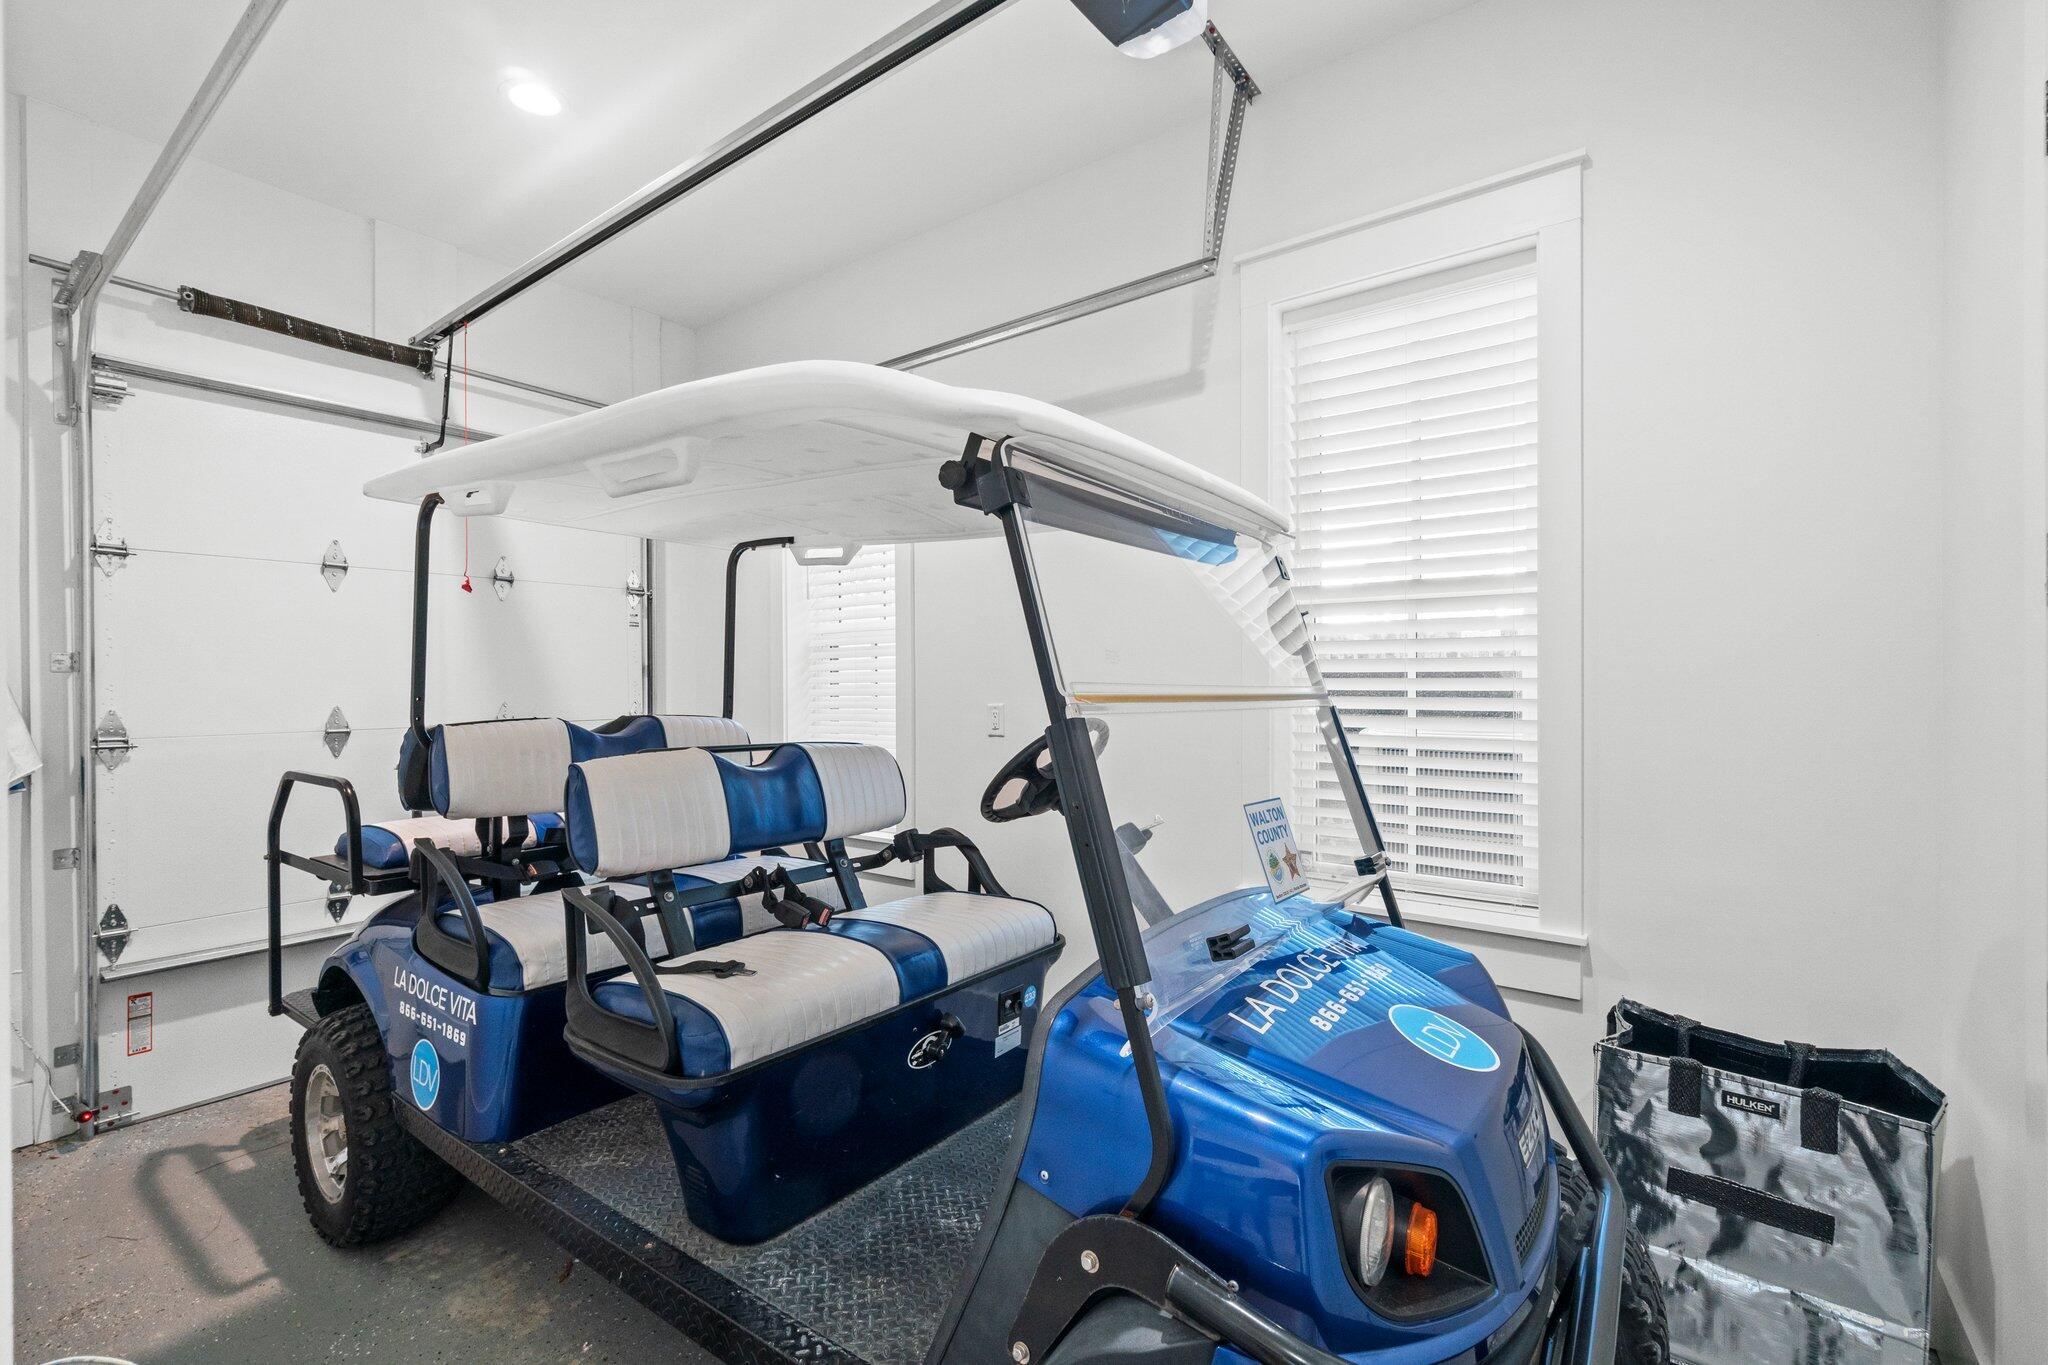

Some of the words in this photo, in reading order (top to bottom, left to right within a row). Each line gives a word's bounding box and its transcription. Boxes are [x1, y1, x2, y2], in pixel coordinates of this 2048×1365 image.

[1249, 806, 1285, 827] WALTON
[1256, 824, 1289, 845] COUNTY
[394, 966, 407, 991] LA
[408, 973, 448, 1011] DOLCE
[450, 991, 477, 1026] VITA
[1227, 996, 1287, 1035] LA
[1259, 947, 1341, 1004] DOLCE
[399, 1001, 467, 1047] 866-651-1869
[1415, 1014, 1467, 1059] LDV
[412, 1055, 439, 1093] LDV
[1726, 1094, 1773, 1113] HULKEN
